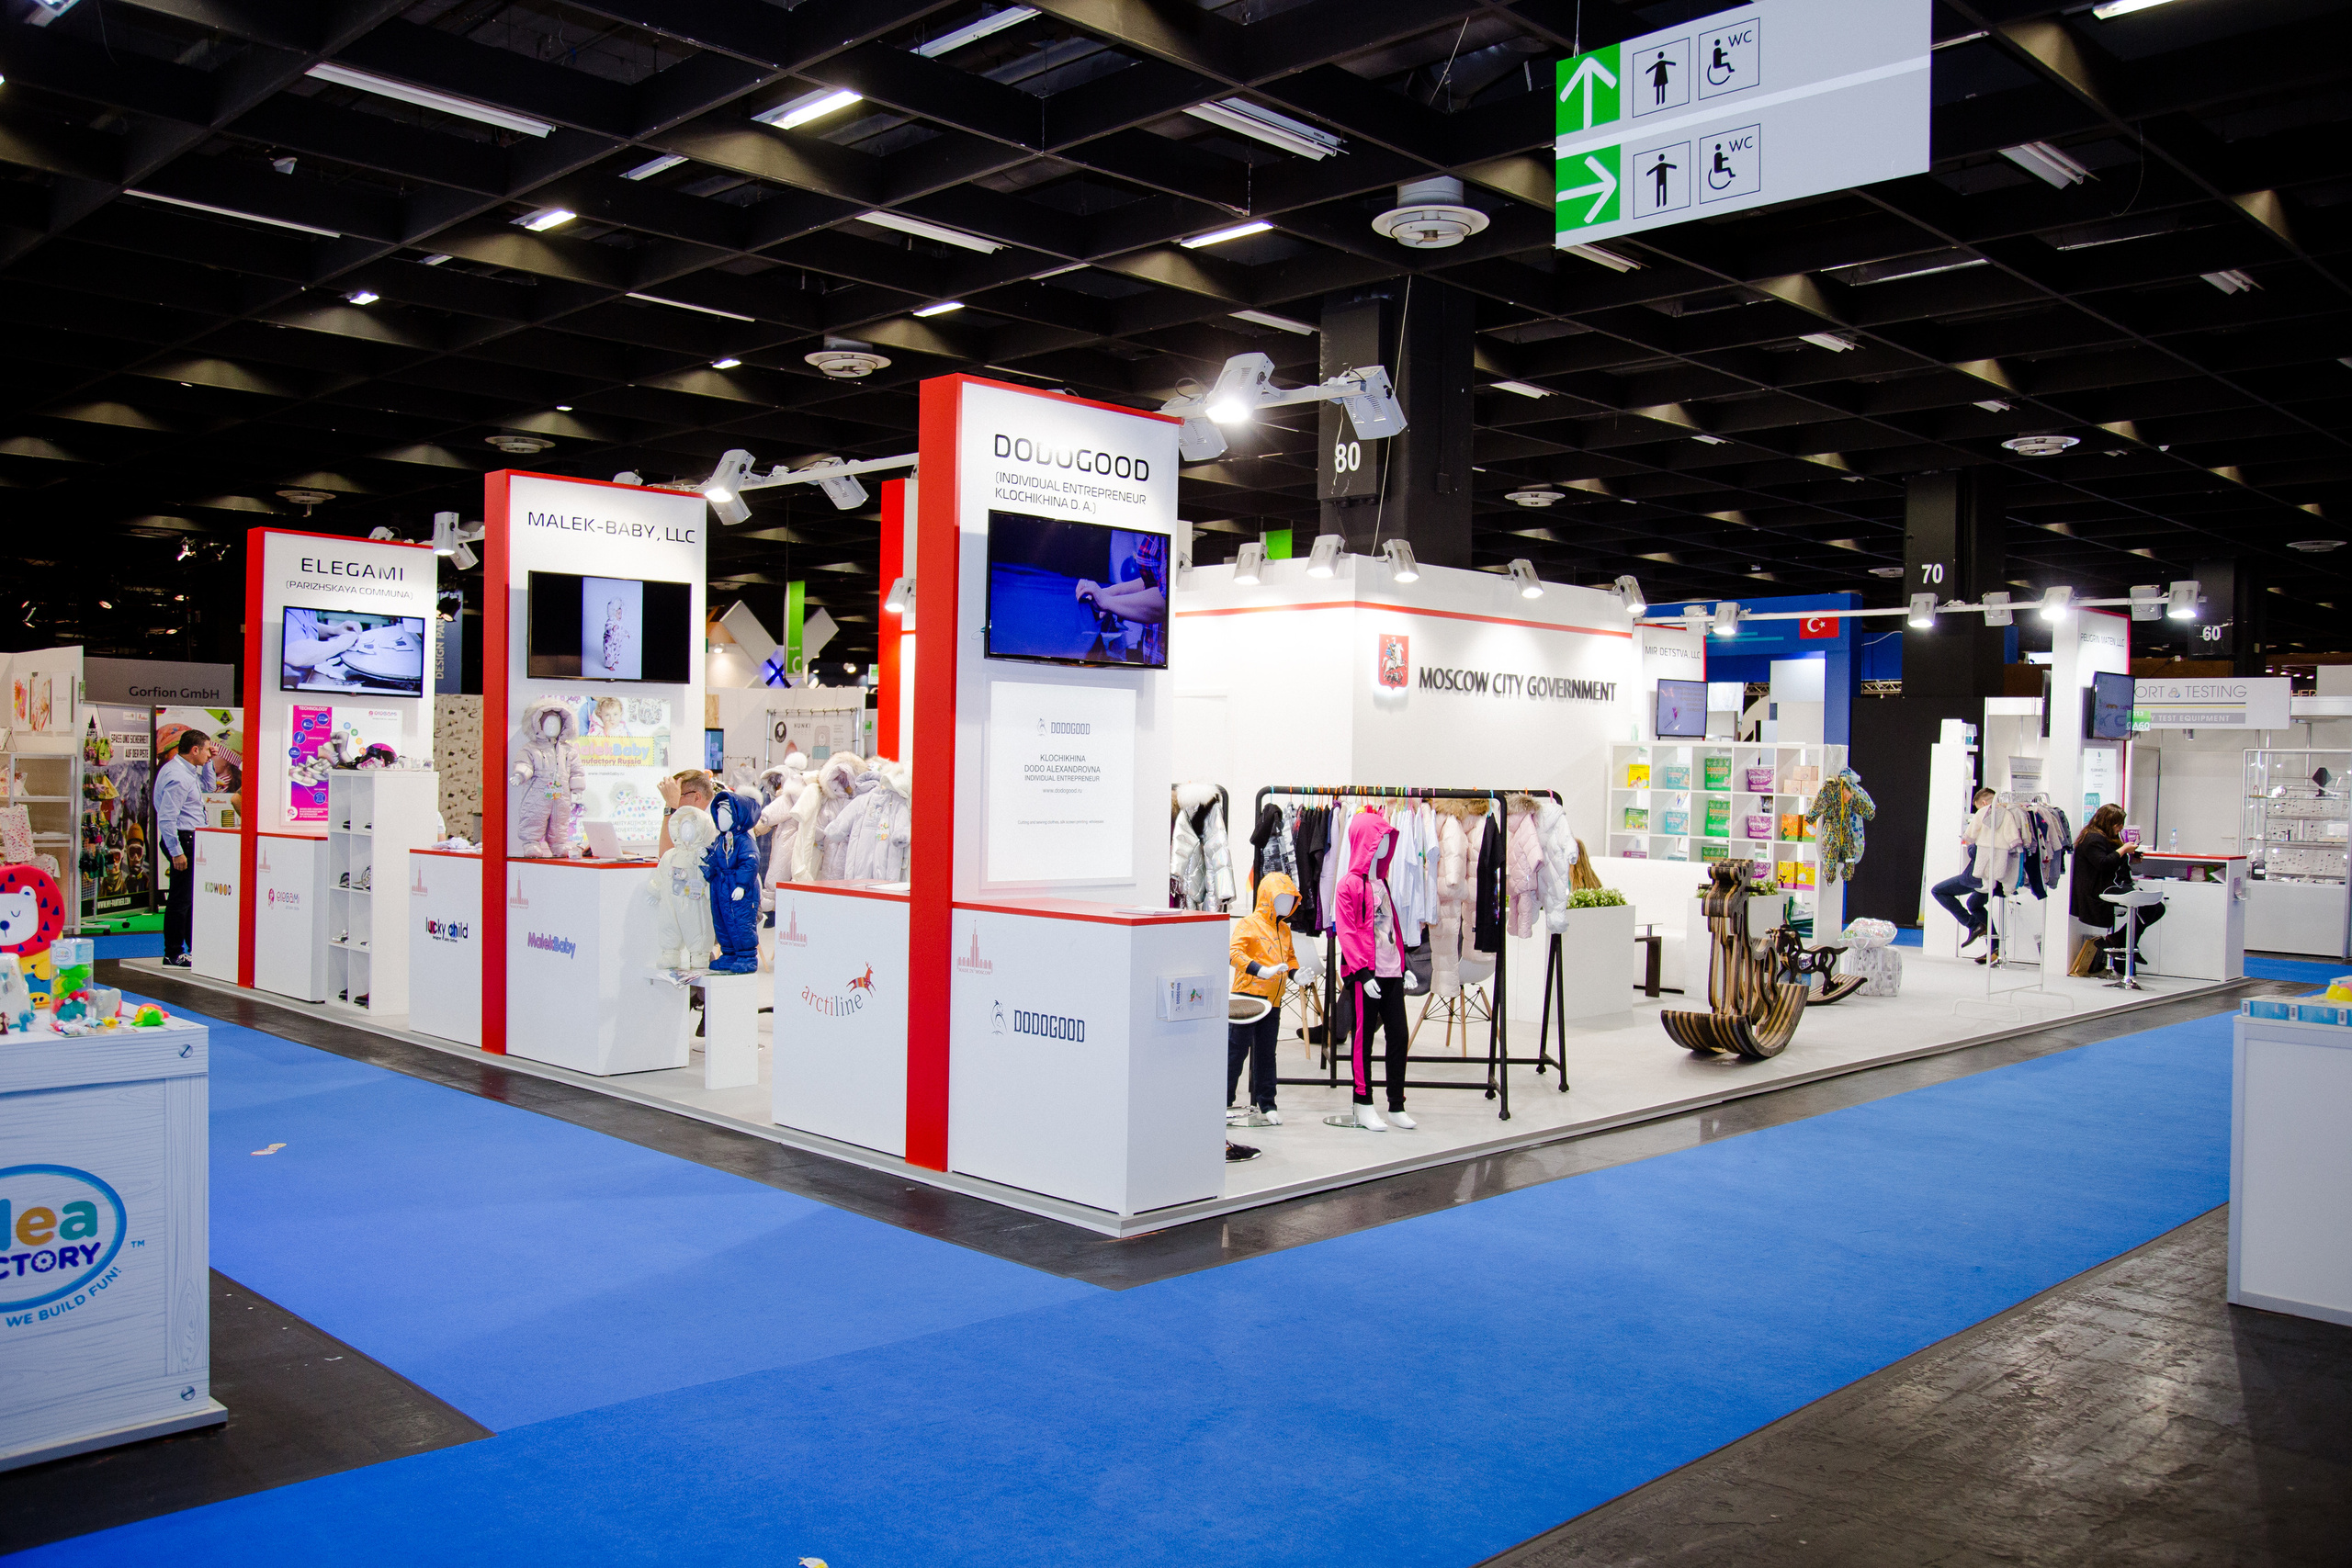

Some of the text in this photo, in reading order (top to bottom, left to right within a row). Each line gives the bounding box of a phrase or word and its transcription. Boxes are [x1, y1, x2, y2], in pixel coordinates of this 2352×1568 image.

[1727, 29, 1753, 48] WC
[1728, 135, 1754, 152] WC
[994, 434, 1149, 482] DODOGOOD
[1335, 441, 1361, 473] 80
[995, 471, 1147, 505] (INDIVIDUAL ENTREPRENEUR
[995, 489, 1096, 514] KLOCHIKHINA D. A.)
[528, 511, 695, 544] MALEK-BABY, LLC
[301, 558, 404, 581] ELEGAMI
[1921, 563, 1944, 584] 70
[286, 580, 413, 601] (PARIZHSKAYA COMMUNA)
[2202, 626, 2222, 641] 60
[435, 641, 445, 680] DESIGN
[1645, 646, 1701, 660] MIR DETSTVA, LLC
[792, 656, 801, 674] C
[129, 685, 220, 700] Gorfion GmbH
[1419, 667, 1617, 702] MOSCOW CITY GOVERNMENT
[2185, 685, 2247, 698] TESTING
[1050, 721, 1091, 735] DODOGOOD
[1023, 764, 1101, 773] DODO ALEXANDROVNA
[1040, 754, 1086, 762] KLOCHIKHINA
[204, 882, 232, 896] KIDWOOD
[425, 916, 469, 940] lucky child
[527, 931, 576, 959] MalekBaby
[801, 986, 864, 1017] arctiline
[1013, 1009, 1085, 1043] DODOGOOD
[130, 1239, 145, 1248] TM
[6, 1266, 122, 1327] WE BUILD FUN!
